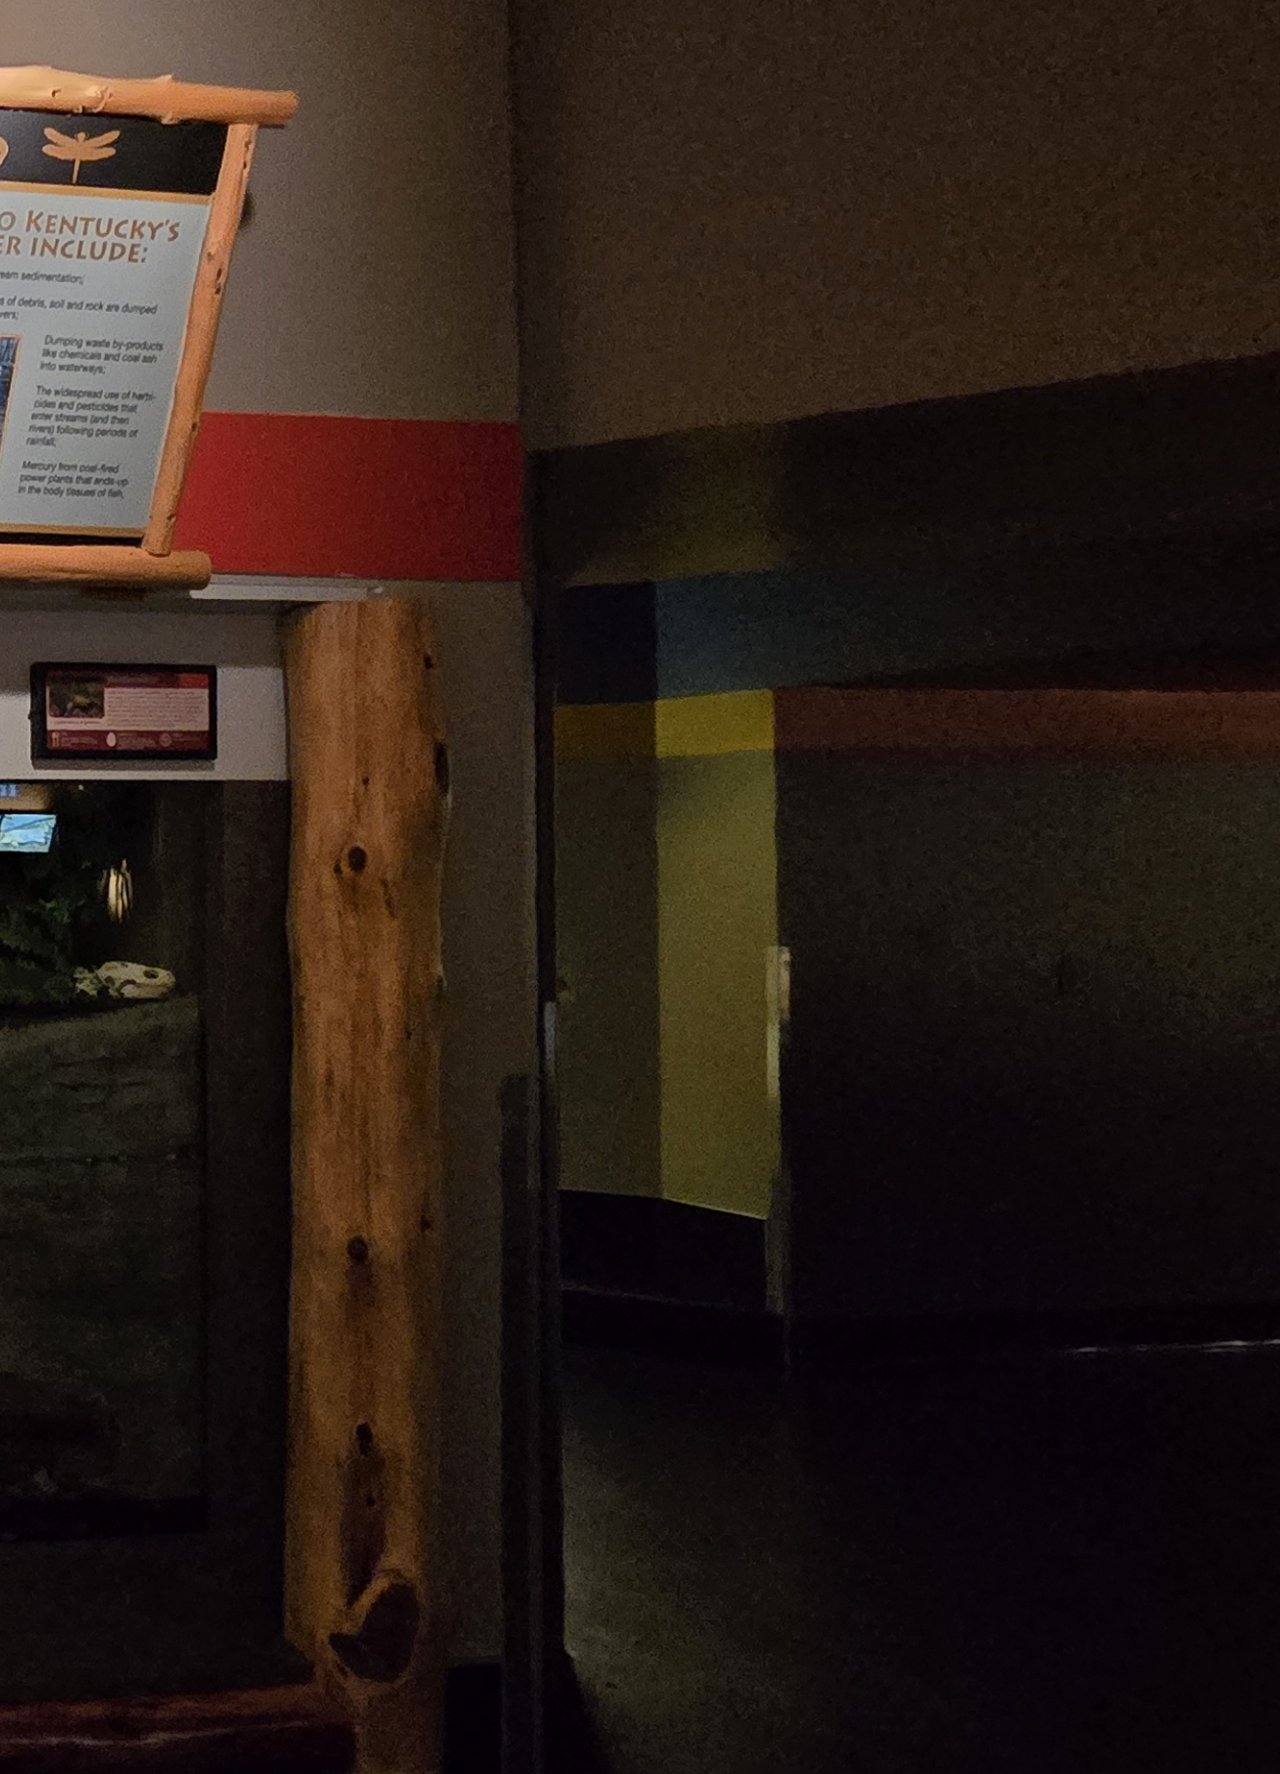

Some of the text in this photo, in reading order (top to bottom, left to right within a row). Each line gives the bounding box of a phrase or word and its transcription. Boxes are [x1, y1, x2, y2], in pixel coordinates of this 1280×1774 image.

[25, 209, 181, 243] KENTUCKY'S
[30, 237, 148, 264] INCLUDE:
[7, 296, 17, 306] of
[66, 301, 83, 311] and
[84, 302, 103, 312] rock
[44, 334, 84, 348] Dumping
[112, 339, 164, 351] by-products
[41, 348, 56, 359] like
[103, 352, 120, 362] and
[121, 353, 140, 363] coal
[142, 355, 157, 364] ash
[40, 361, 56, 372] into
[36, 385, 52, 397] The
[53, 387, 103, 400] widespread
[104, 390, 120, 400] use
[121, 390, 130, 400] of
[58, 400, 75, 411] and
[121, 404, 139, 414] that
[128, 428, 139, 439] of
[22, 460, 58, 473] Mercury
[75, 475, 93, 485] that
[18, 485, 26, 495] in
[27, 485, 42, 495] the
[43, 486, 64, 498] body
[97, 488, 107, 498] of
